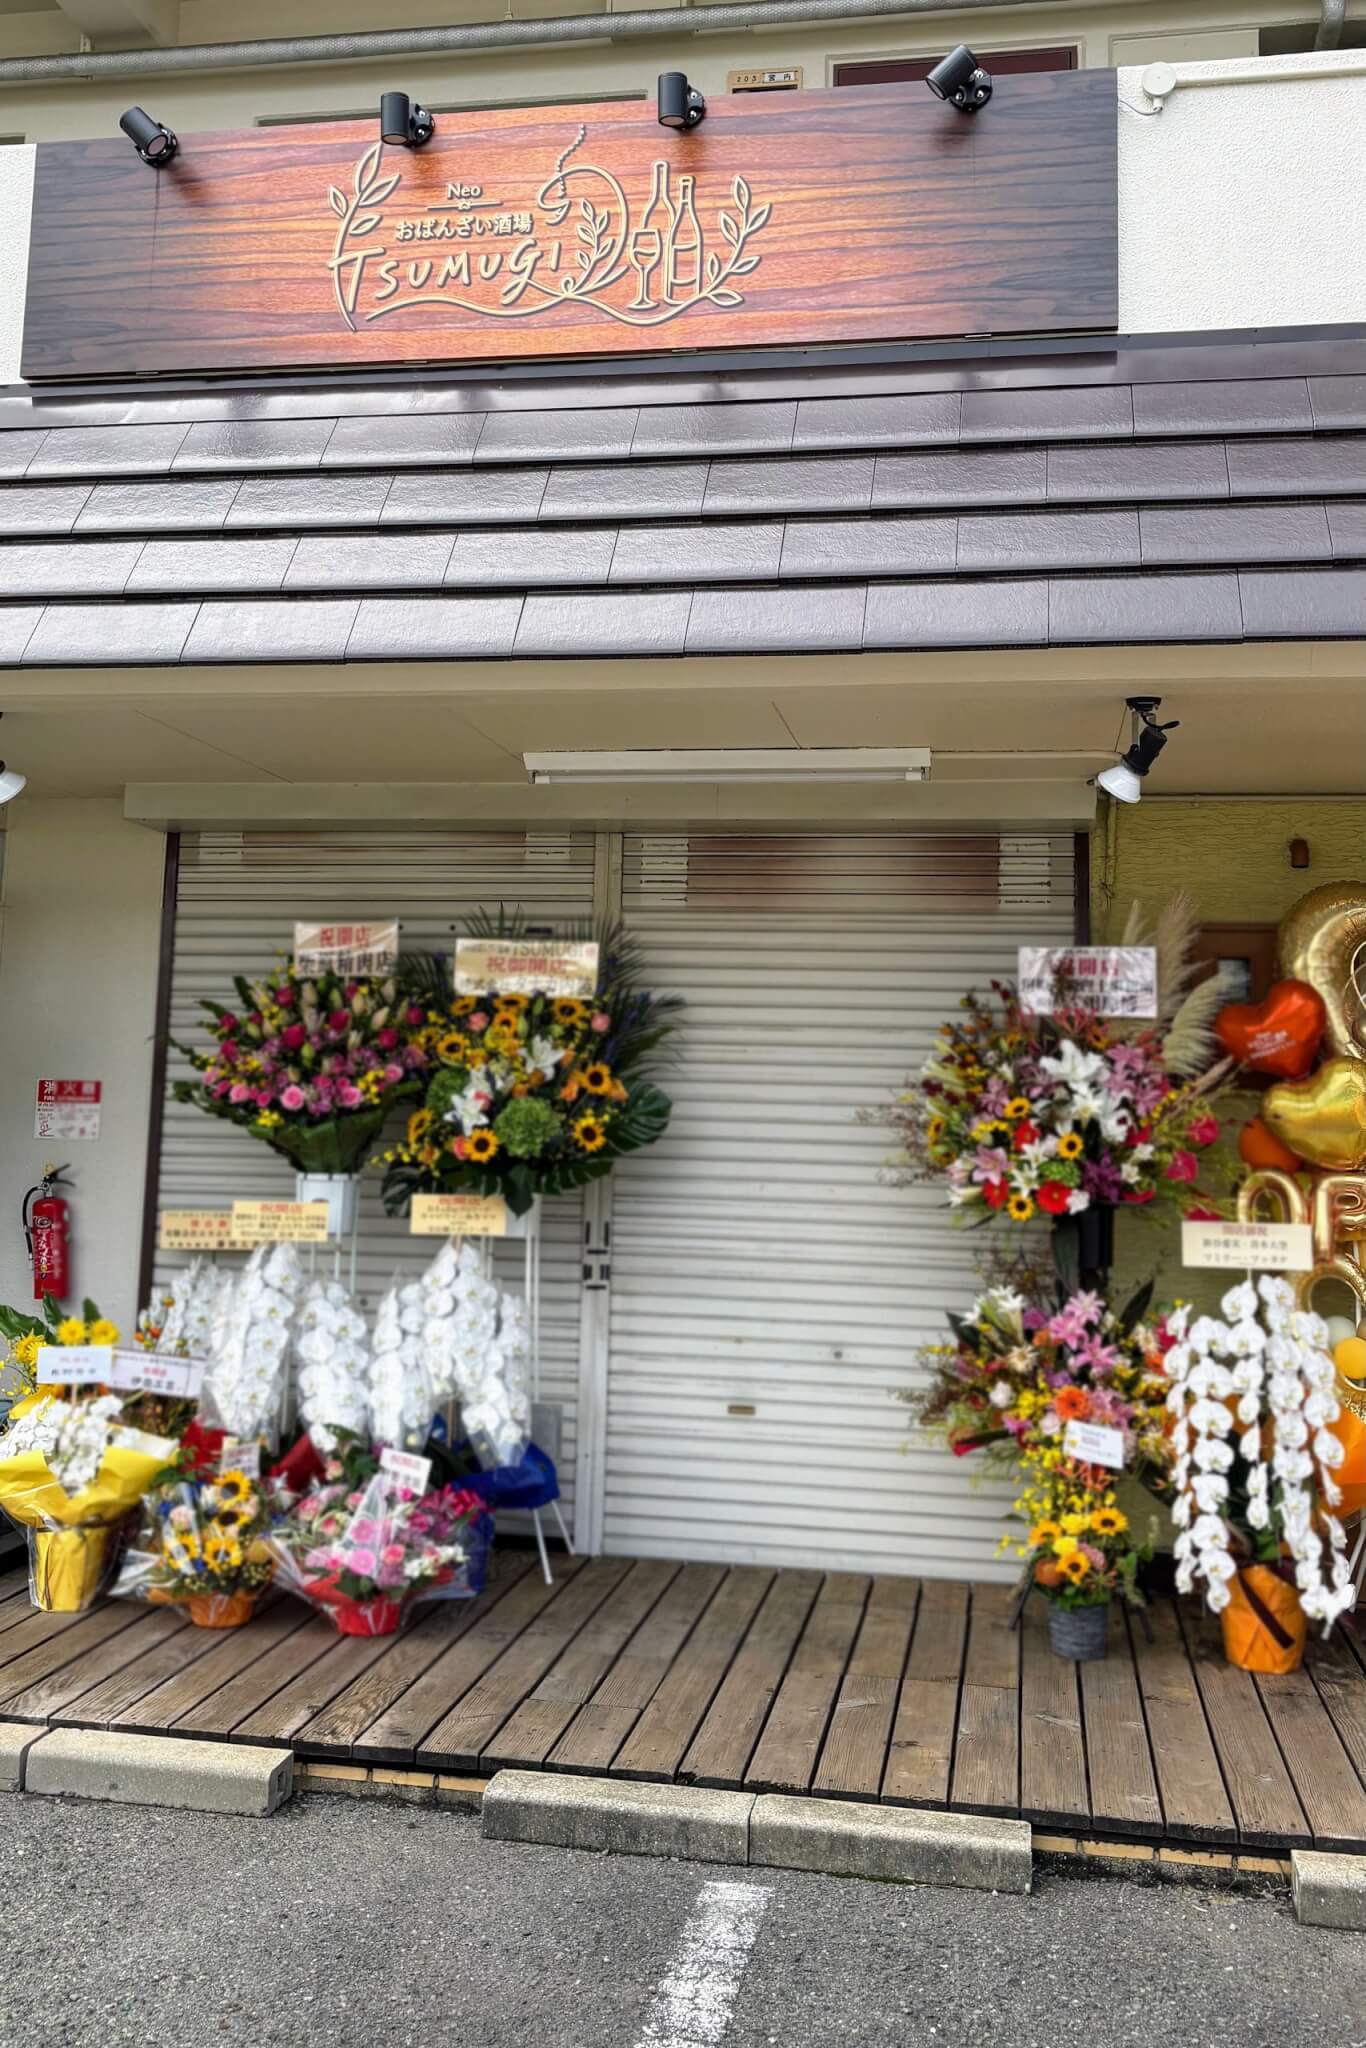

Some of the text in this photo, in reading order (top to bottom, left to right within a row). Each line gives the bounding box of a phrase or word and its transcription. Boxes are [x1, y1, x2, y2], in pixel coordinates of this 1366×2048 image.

[446, 182, 482, 199] Neo
[395, 213, 534, 241] おばんざい酒場
[328, 239, 561, 313] TSUMUGI
[319, 926, 369, 949] 祝開店
